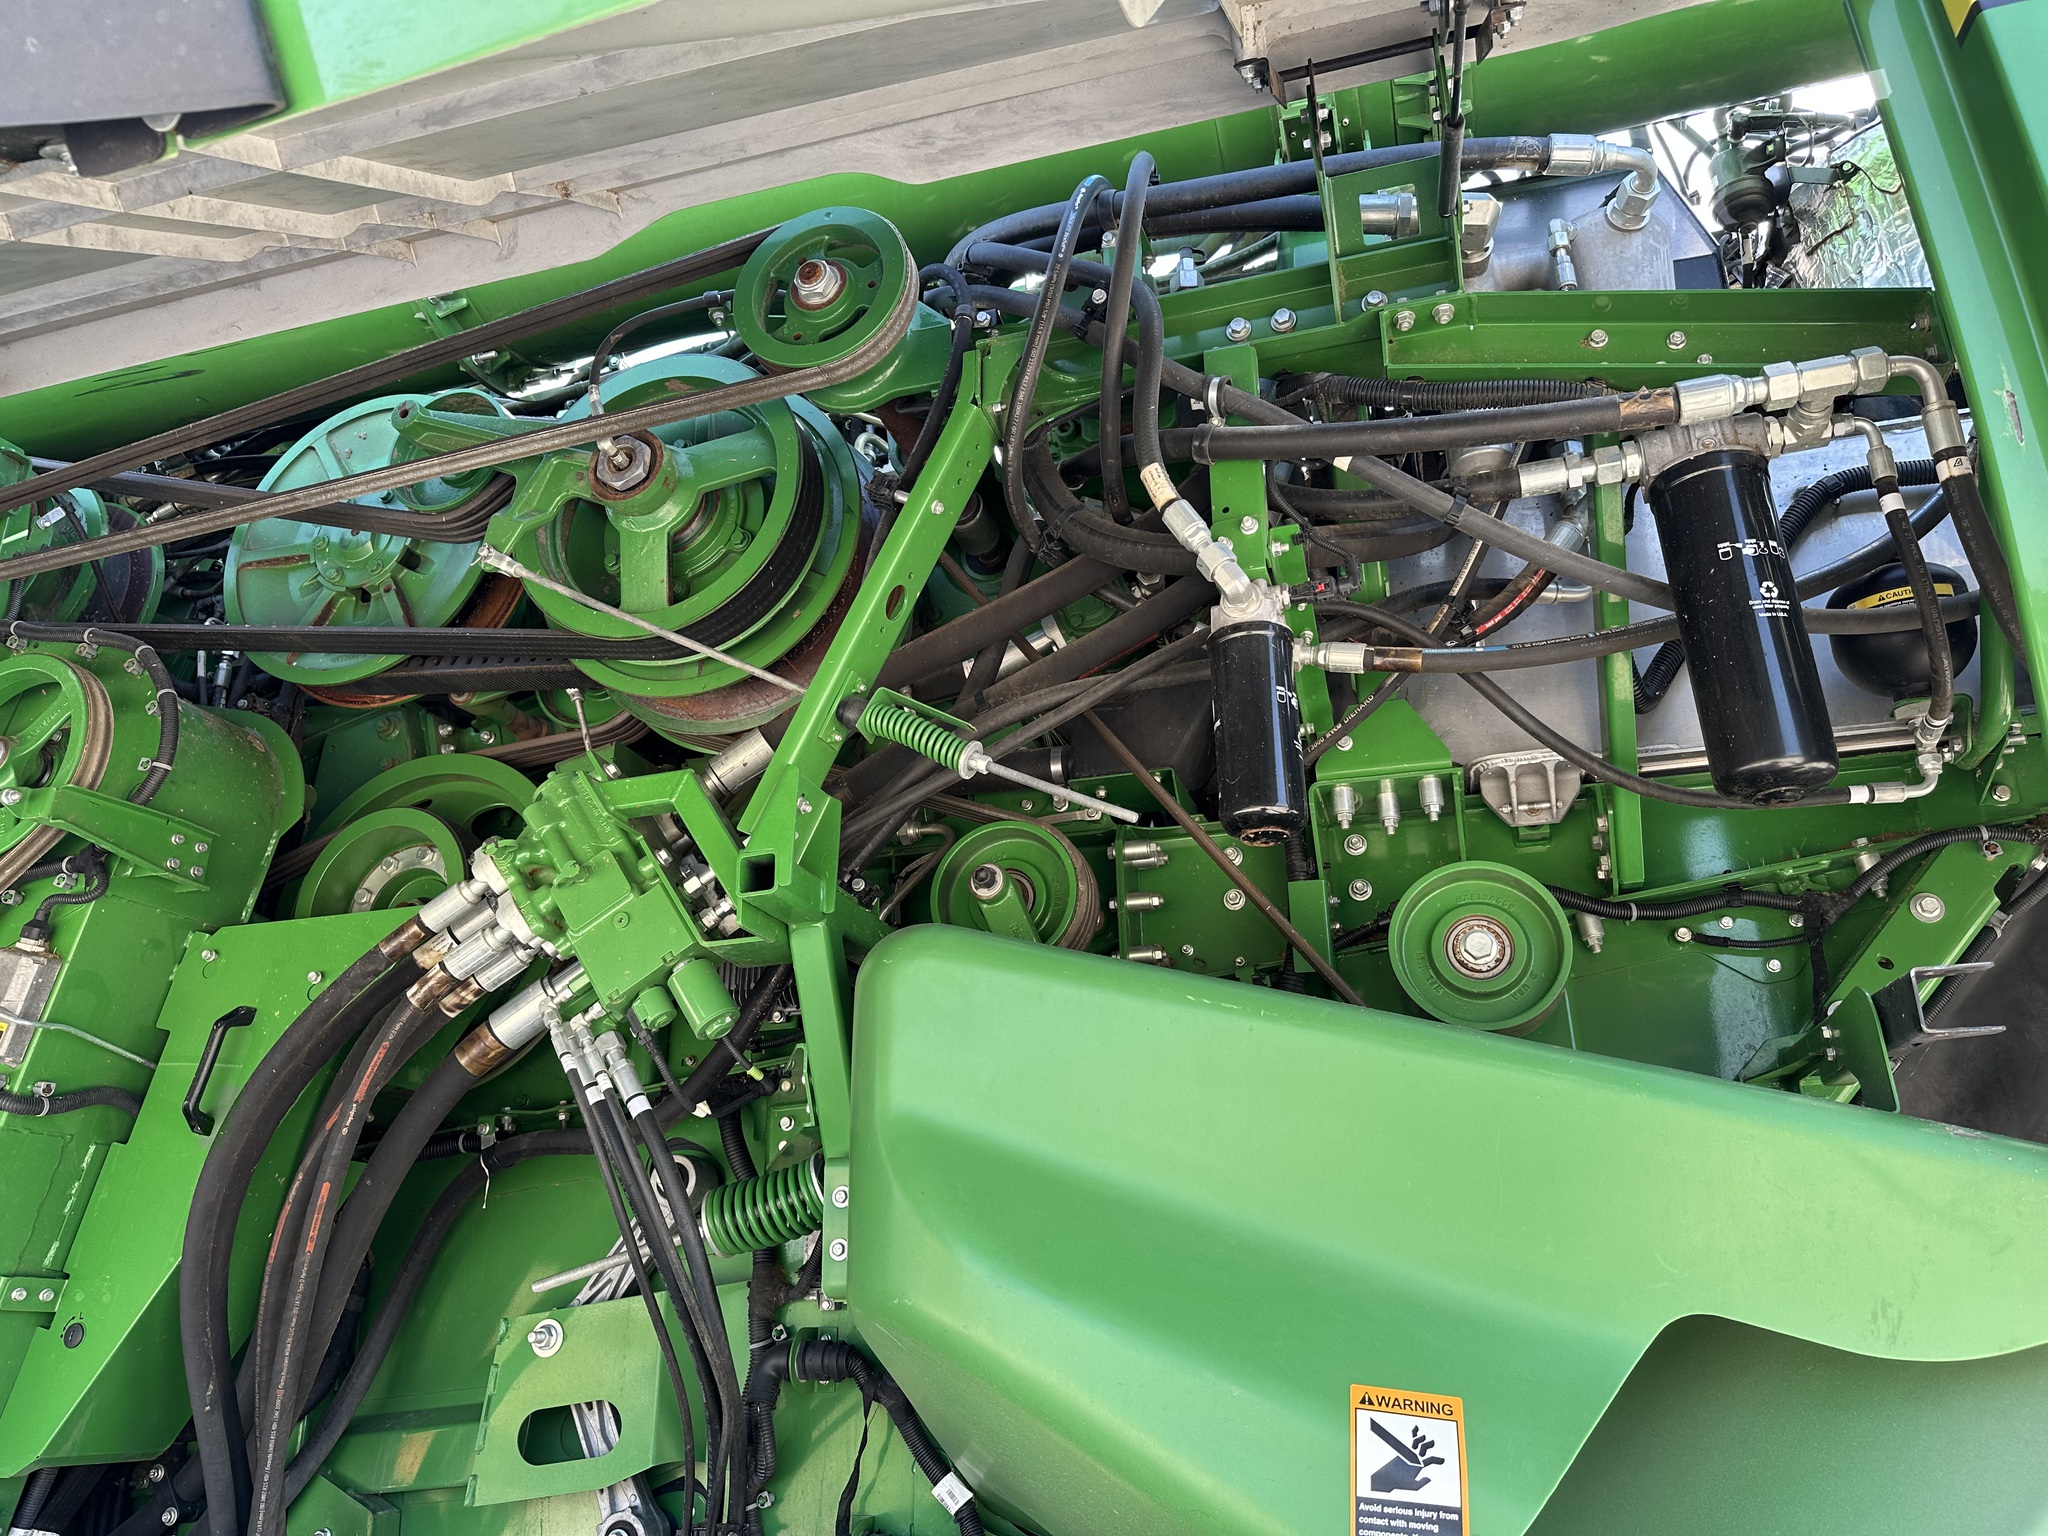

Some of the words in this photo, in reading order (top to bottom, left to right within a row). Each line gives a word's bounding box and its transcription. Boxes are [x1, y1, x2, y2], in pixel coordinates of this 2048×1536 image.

[1886, 589, 1911, 599] CAUTI
[1921, 576, 1934, 599] ITALY
[1341, 693, 1375, 723] DIEHARD
[1375, 1395, 1454, 1416] WARNING
[1359, 1502, 1382, 1512] Avoid
[1383, 1506, 1413, 1516] serious
[1415, 1508, 1437, 1520] injury
[1439, 1511, 1459, 1521] from
[1359, 1516, 1388, 1526] contact
[1390, 1519, 1407, 1528] with
[1409, 1522, 1439, 1533] moving
